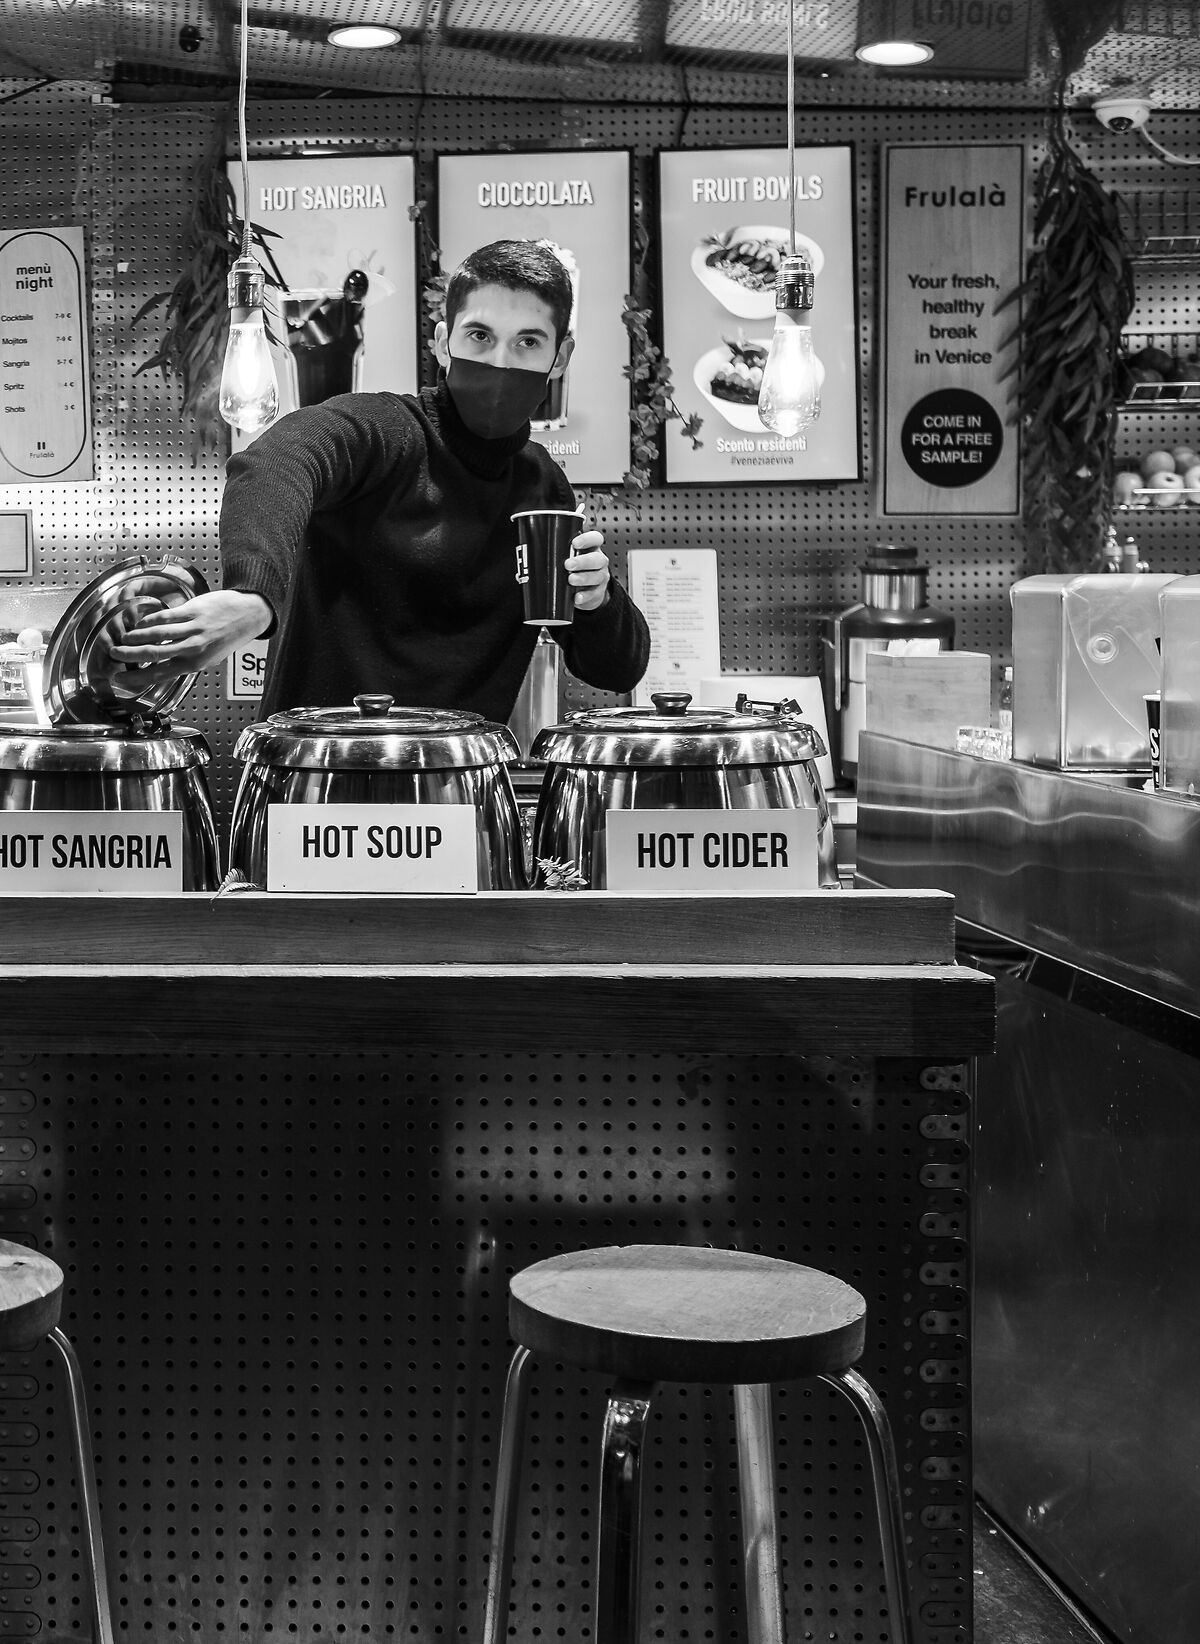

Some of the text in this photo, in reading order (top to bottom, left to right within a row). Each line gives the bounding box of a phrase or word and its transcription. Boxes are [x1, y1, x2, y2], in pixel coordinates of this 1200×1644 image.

[478, 180, 593, 208] CIOCCOLATA
[692, 174, 823, 203] FRUIT BOWLS
[904, 183, 1006, 208] Frulalà
[260, 184, 386, 211] HOT SANGRIA
[16, 263, 51, 275] menù
[16, 277, 53, 292] night
[908, 273, 1000, 290] Your fresh,
[922, 299, 985, 317] healthy
[930, 324, 978, 339] break
[915, 349, 992, 364] in Venice
[923, 415, 981, 428] COME IN
[716, 436, 807, 453] Sconto residenti
[912, 433, 992, 446] FOR A FREE
[921, 451, 983, 464] SAMPLE!
[302, 825, 443, 859] HOT SOUP
[638, 832, 789, 869] HOT CIDER
[51, 834, 173, 868] SANGRIA
